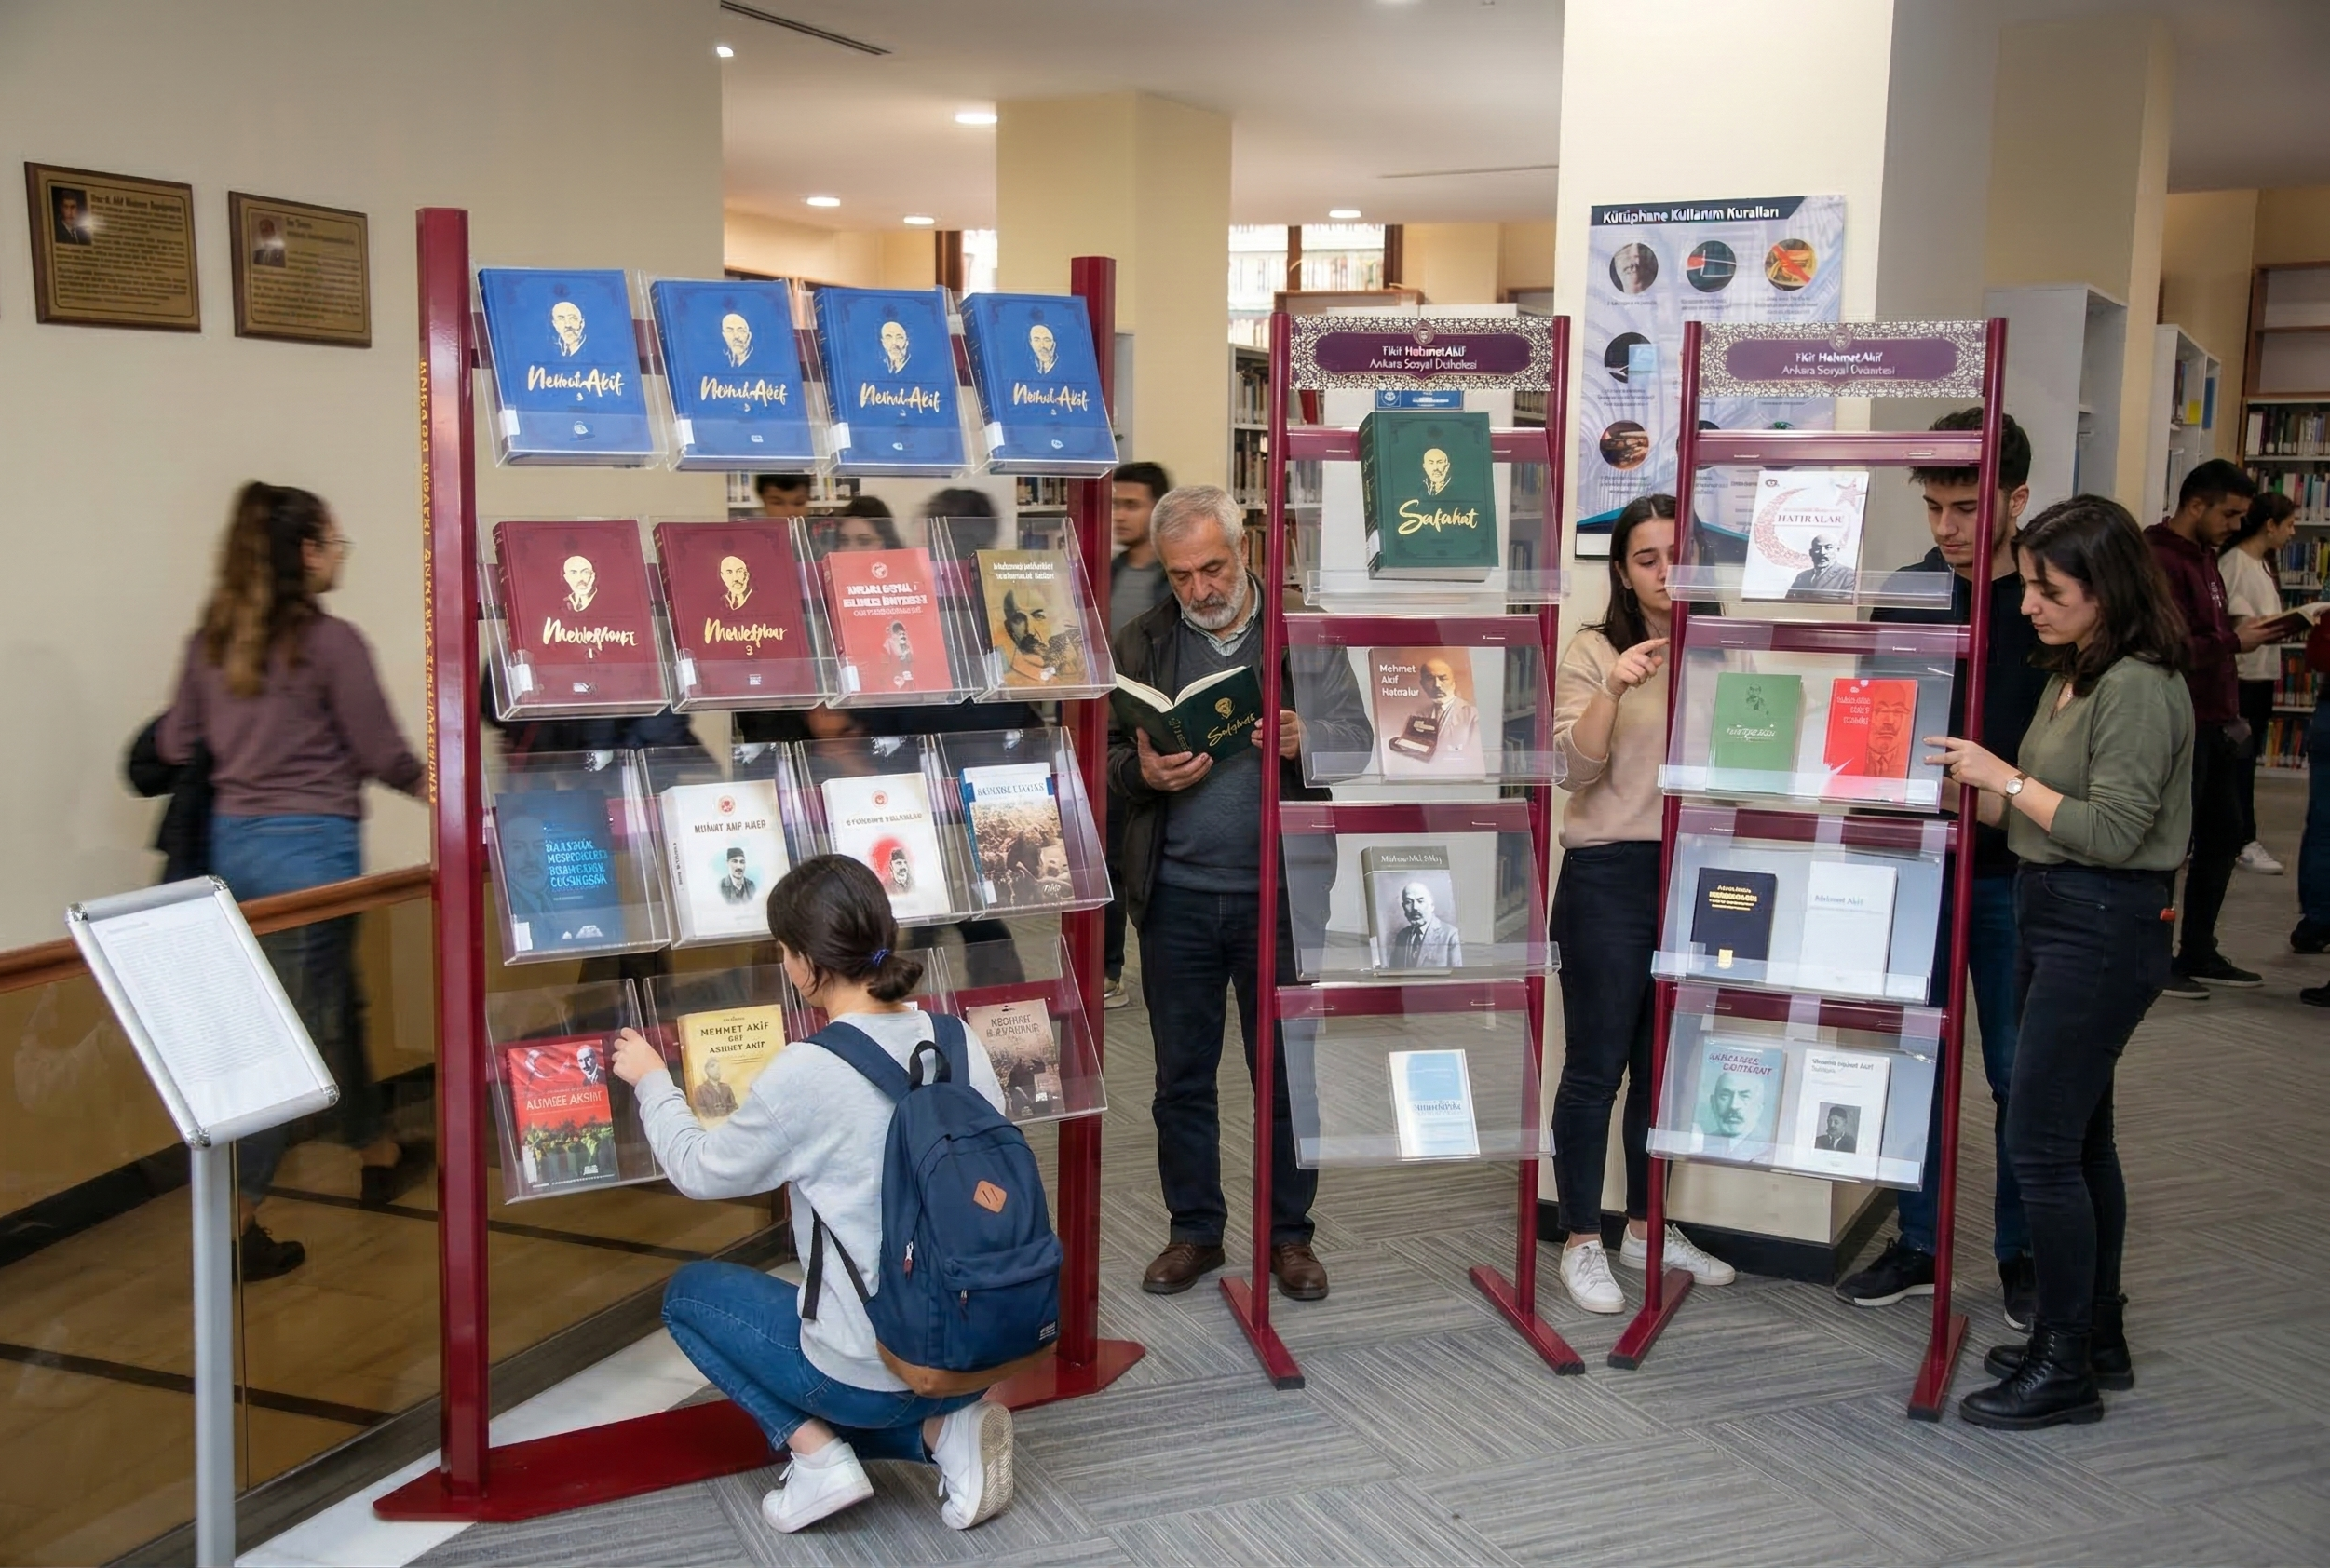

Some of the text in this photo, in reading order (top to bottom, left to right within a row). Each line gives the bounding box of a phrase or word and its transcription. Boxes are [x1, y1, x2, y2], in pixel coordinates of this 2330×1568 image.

[1603, 205, 1780, 225] Kütüphane Kullanım Kuralları
[1777, 514, 1843, 524] HATIRALAR
[1379, 664, 1416, 673] Mehmet
[700, 1021, 769, 1036] MEHMET AKİF
